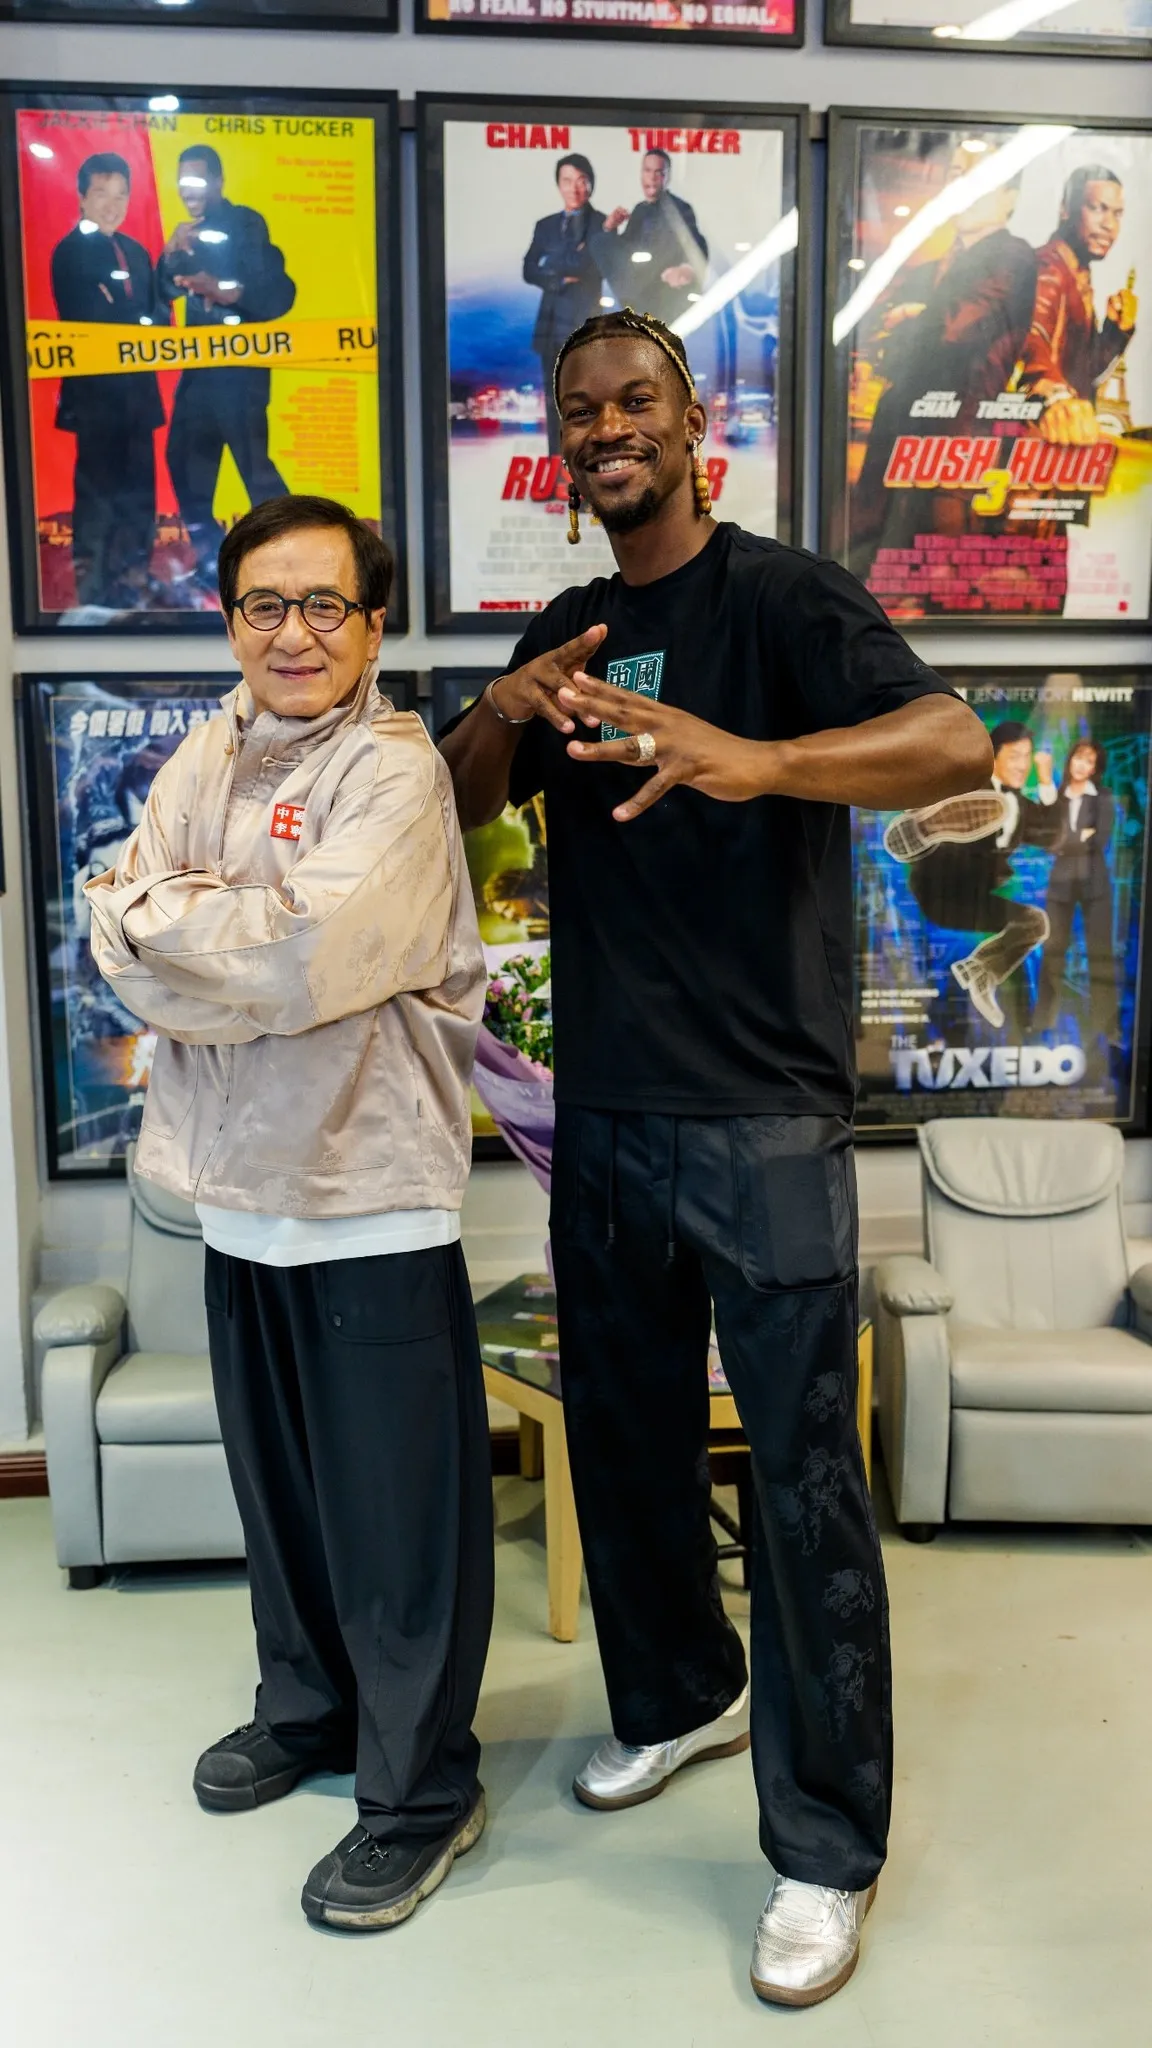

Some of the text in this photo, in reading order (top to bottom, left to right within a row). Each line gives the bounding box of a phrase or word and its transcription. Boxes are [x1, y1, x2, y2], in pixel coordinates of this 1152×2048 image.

[540, 0, 567, 17] NO
[681, 4, 707, 24] NO
[205, 117, 264, 135] CHRIS
[272, 119, 355, 138] TUCKER
[486, 123, 741, 154] CHAN TUCKER
[28, 346, 75, 369] UR
[118, 336, 200, 365] RUSH
[208, 332, 292, 357] HOUR
[909, 400, 1043, 420] CHAN TUCKER
[883, 435, 1118, 492] RUSH HOUR
[971, 468, 1012, 516] 3
[1072, 687, 1135, 702] HEWITT
[891, 1034, 917, 1049] THE
[889, 1044, 1087, 1090] TUXEDO
